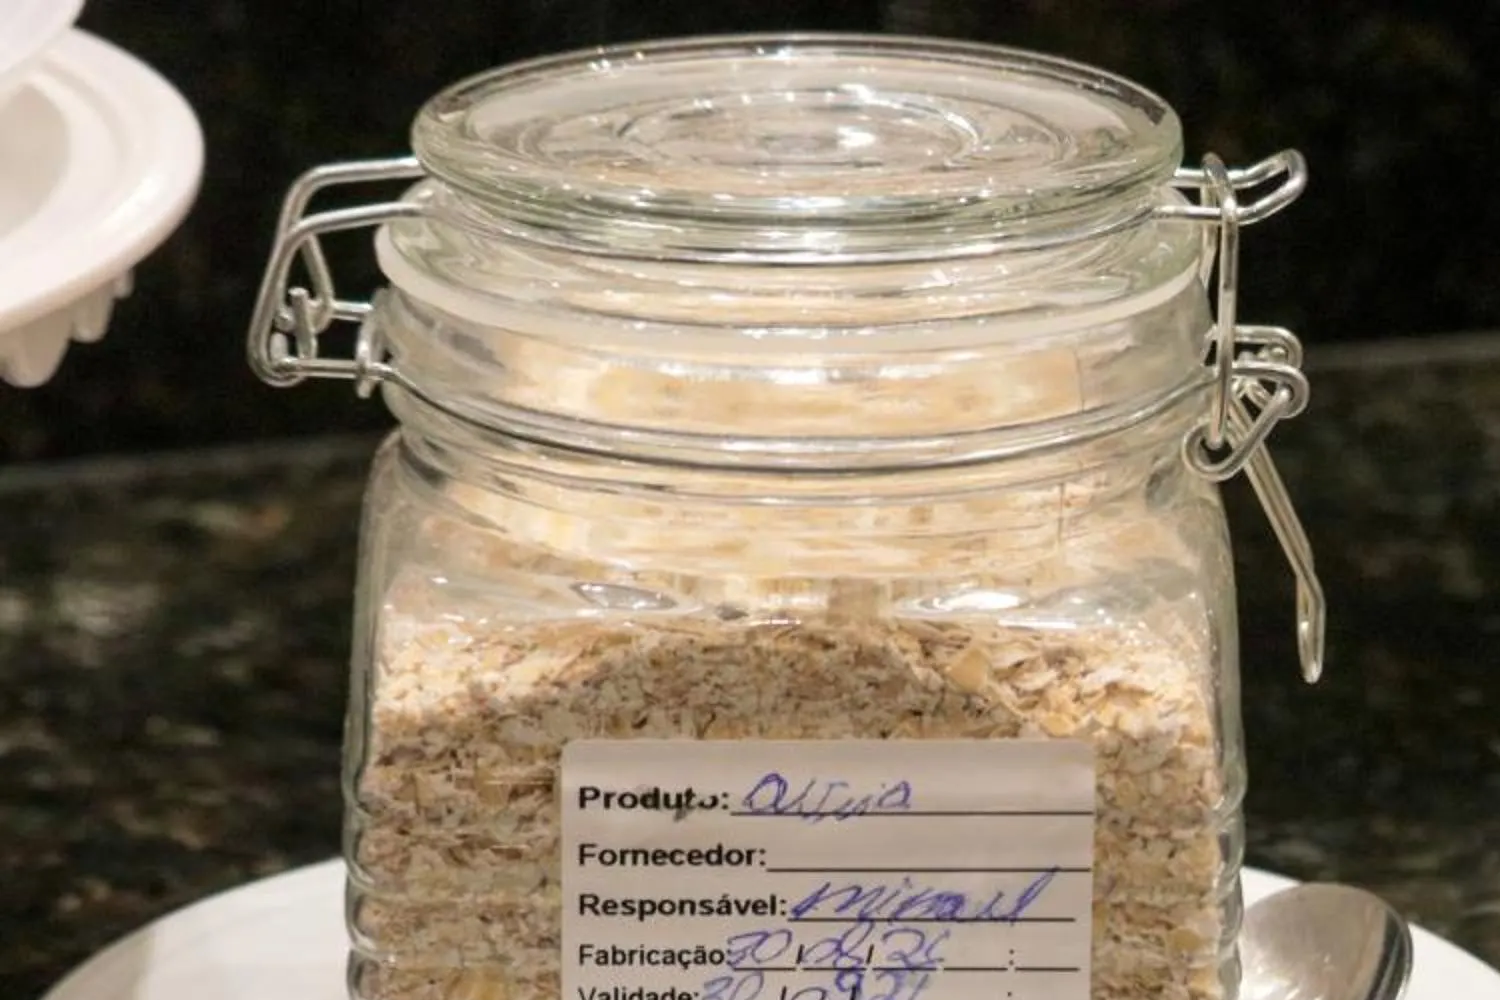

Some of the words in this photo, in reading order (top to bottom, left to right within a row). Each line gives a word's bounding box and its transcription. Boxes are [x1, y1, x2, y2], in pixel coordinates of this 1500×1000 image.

[578, 785, 729, 811] Produto:
[578, 843, 767, 867] Fornecedor:
[578, 892, 787, 922] Responsável:
[578, 943, 733, 968] Fabricação:
